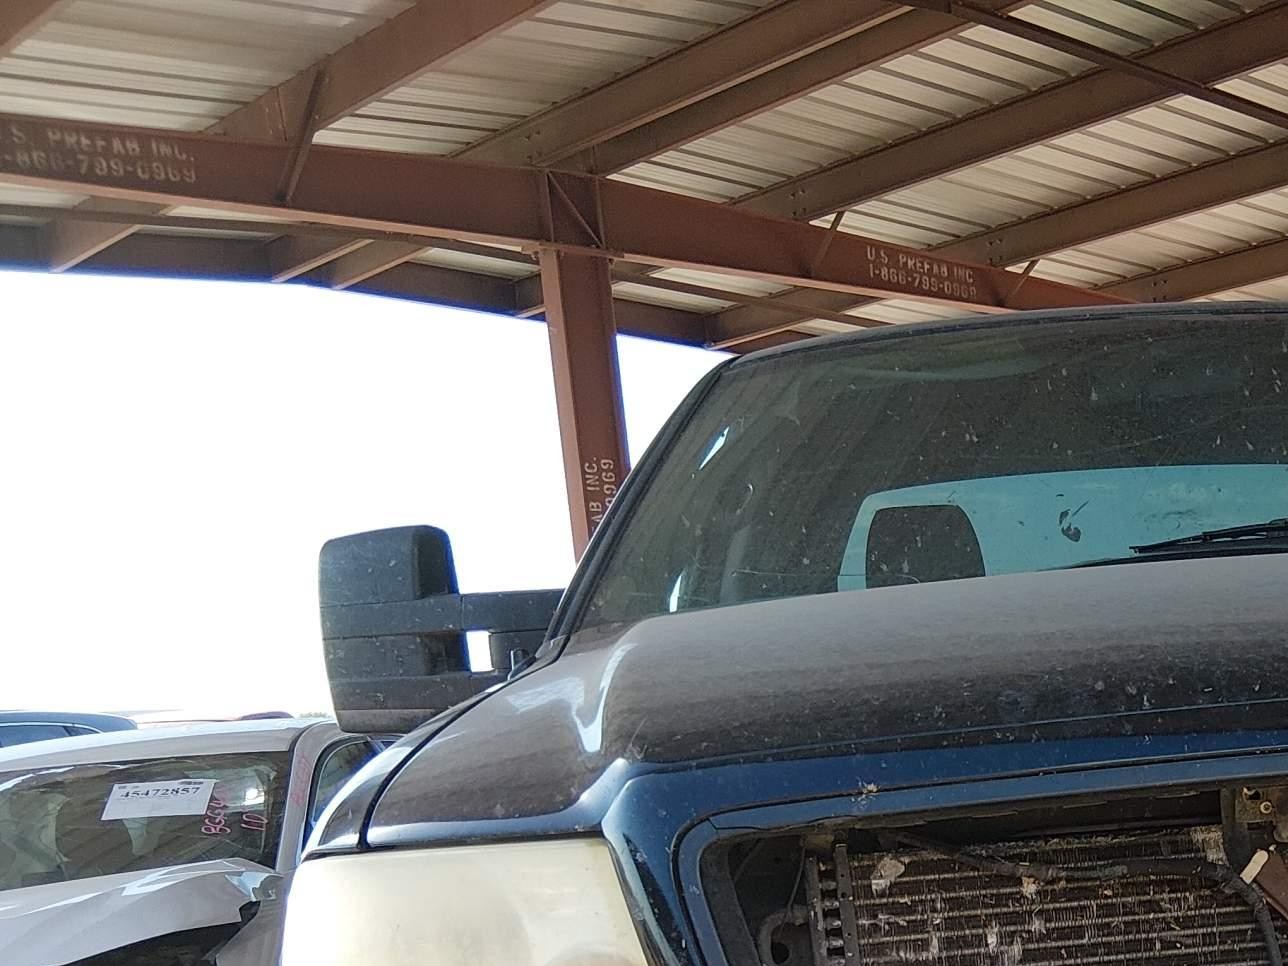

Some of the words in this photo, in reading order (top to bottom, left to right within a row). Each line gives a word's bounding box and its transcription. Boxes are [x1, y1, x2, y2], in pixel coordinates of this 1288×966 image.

[48, 128, 141, 156] PREFAB
[899, 252, 948, 278] PREFAB
[583, 456, 601, 492] INC.
[120, 786, 201, 799] 45472857
